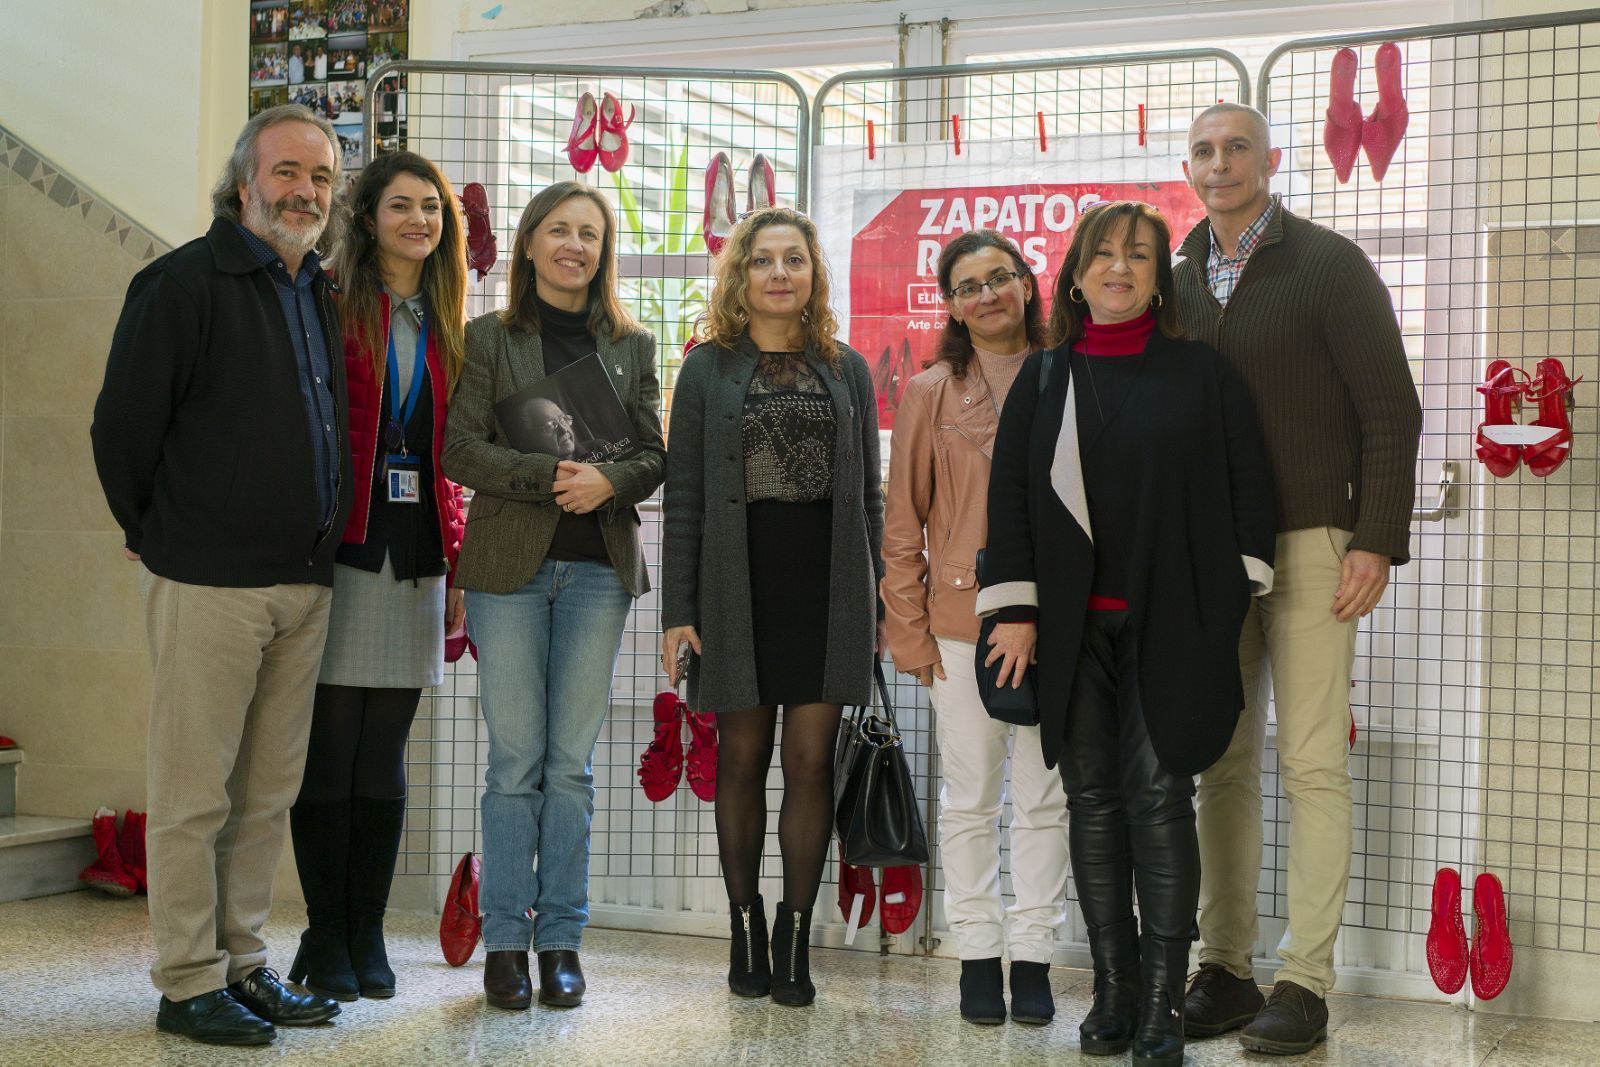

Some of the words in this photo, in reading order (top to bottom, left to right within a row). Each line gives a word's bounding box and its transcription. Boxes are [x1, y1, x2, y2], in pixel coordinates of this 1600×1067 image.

[917, 292, 944, 304] ELIN
[906, 319, 931, 330] Arte
[933, 321, 947, 330] co
[603, 437, 631, 453] Egea
